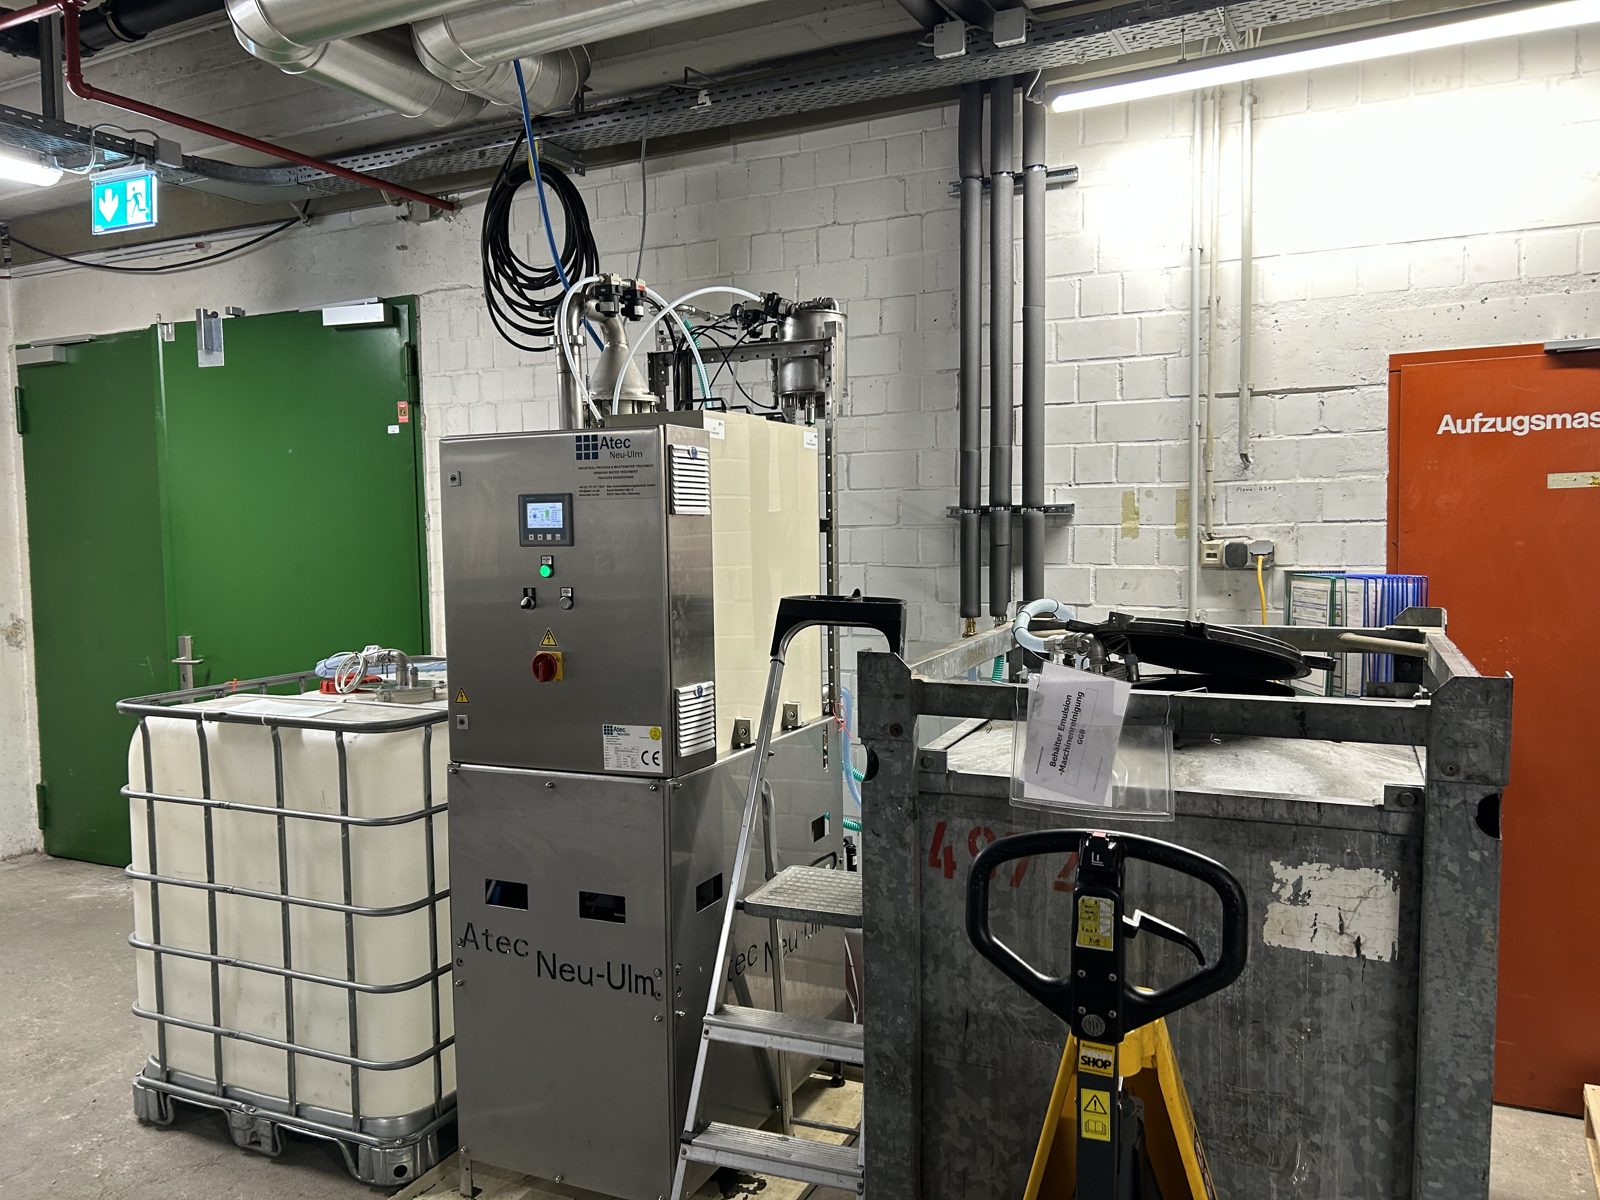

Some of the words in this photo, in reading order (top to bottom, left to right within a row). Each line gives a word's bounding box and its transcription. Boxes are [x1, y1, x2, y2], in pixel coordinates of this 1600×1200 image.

[1436, 411, 1600, 436] Aufzugsmas
[600, 436, 631, 450] Atec
[609, 450, 643, 459] Neu-Ulm
[1049, 730, 1063, 768] Behälter
[1058, 694, 1072, 732] Emulsion
[1058, 691, 1085, 776] -Maschinenreinigung
[462, 922, 529, 957] Atec
[536, 950, 655, 997] Neu-Ulm
[1080, 1055, 1111, 1070] SHOP
